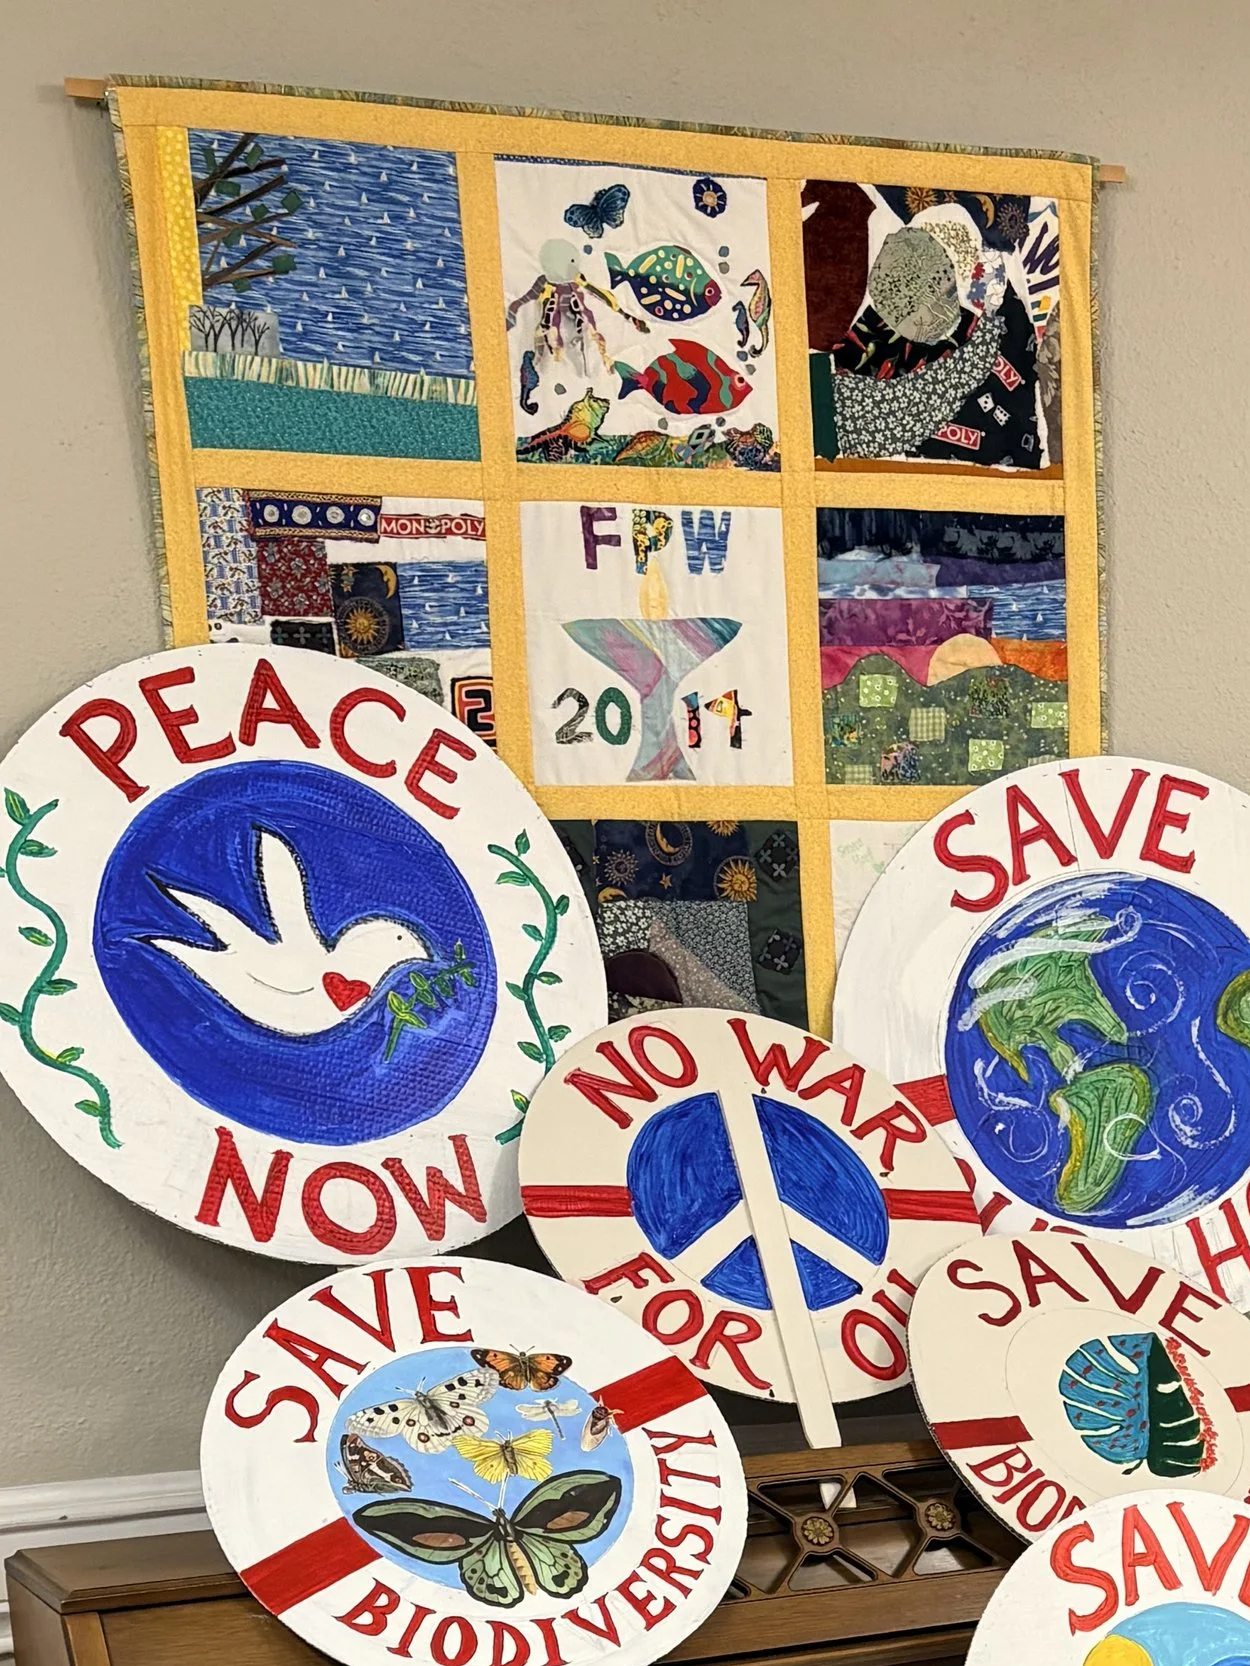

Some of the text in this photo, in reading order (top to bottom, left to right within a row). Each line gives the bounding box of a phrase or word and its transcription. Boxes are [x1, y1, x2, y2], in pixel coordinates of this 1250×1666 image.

[580, 505, 732, 576] FPW
[59, 658, 477, 819] PEACE
[934, 768, 1209, 913] SAVE
[565, 1019, 927, 1171] NO WAR
[195, 1126, 487, 1255] NOW
[224, 1266, 473, 1443] SAVE
[584, 1252, 773, 1391] FOR
[947, 1240, 1222, 1357] SAVE
